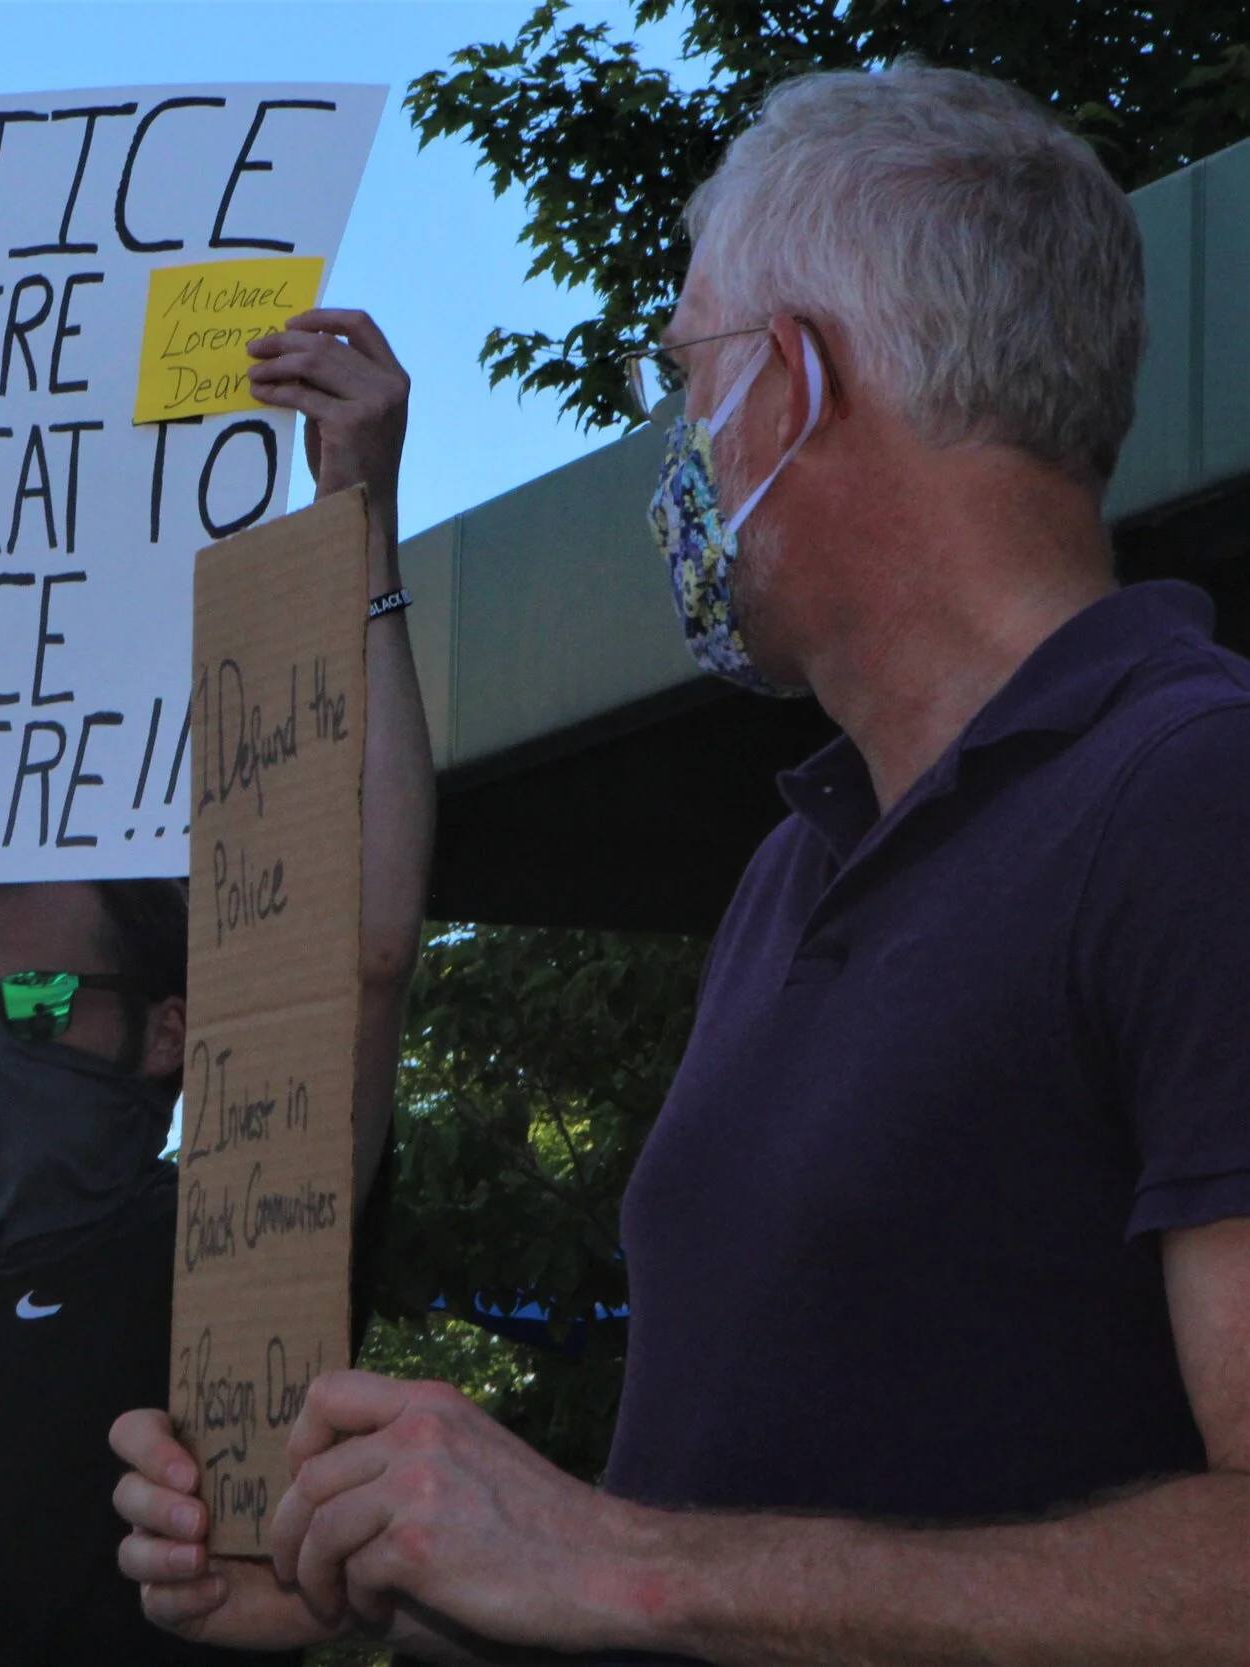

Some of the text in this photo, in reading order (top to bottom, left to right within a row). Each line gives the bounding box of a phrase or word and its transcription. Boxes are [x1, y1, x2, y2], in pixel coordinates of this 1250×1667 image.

[132, 413, 278, 544] TO
[309, 655, 348, 744] the
[213, 839, 288, 950] Police
[286, 1075, 308, 1136] in
[184, 1179, 236, 1274] Black
[205, 1447, 268, 1547] Trump
